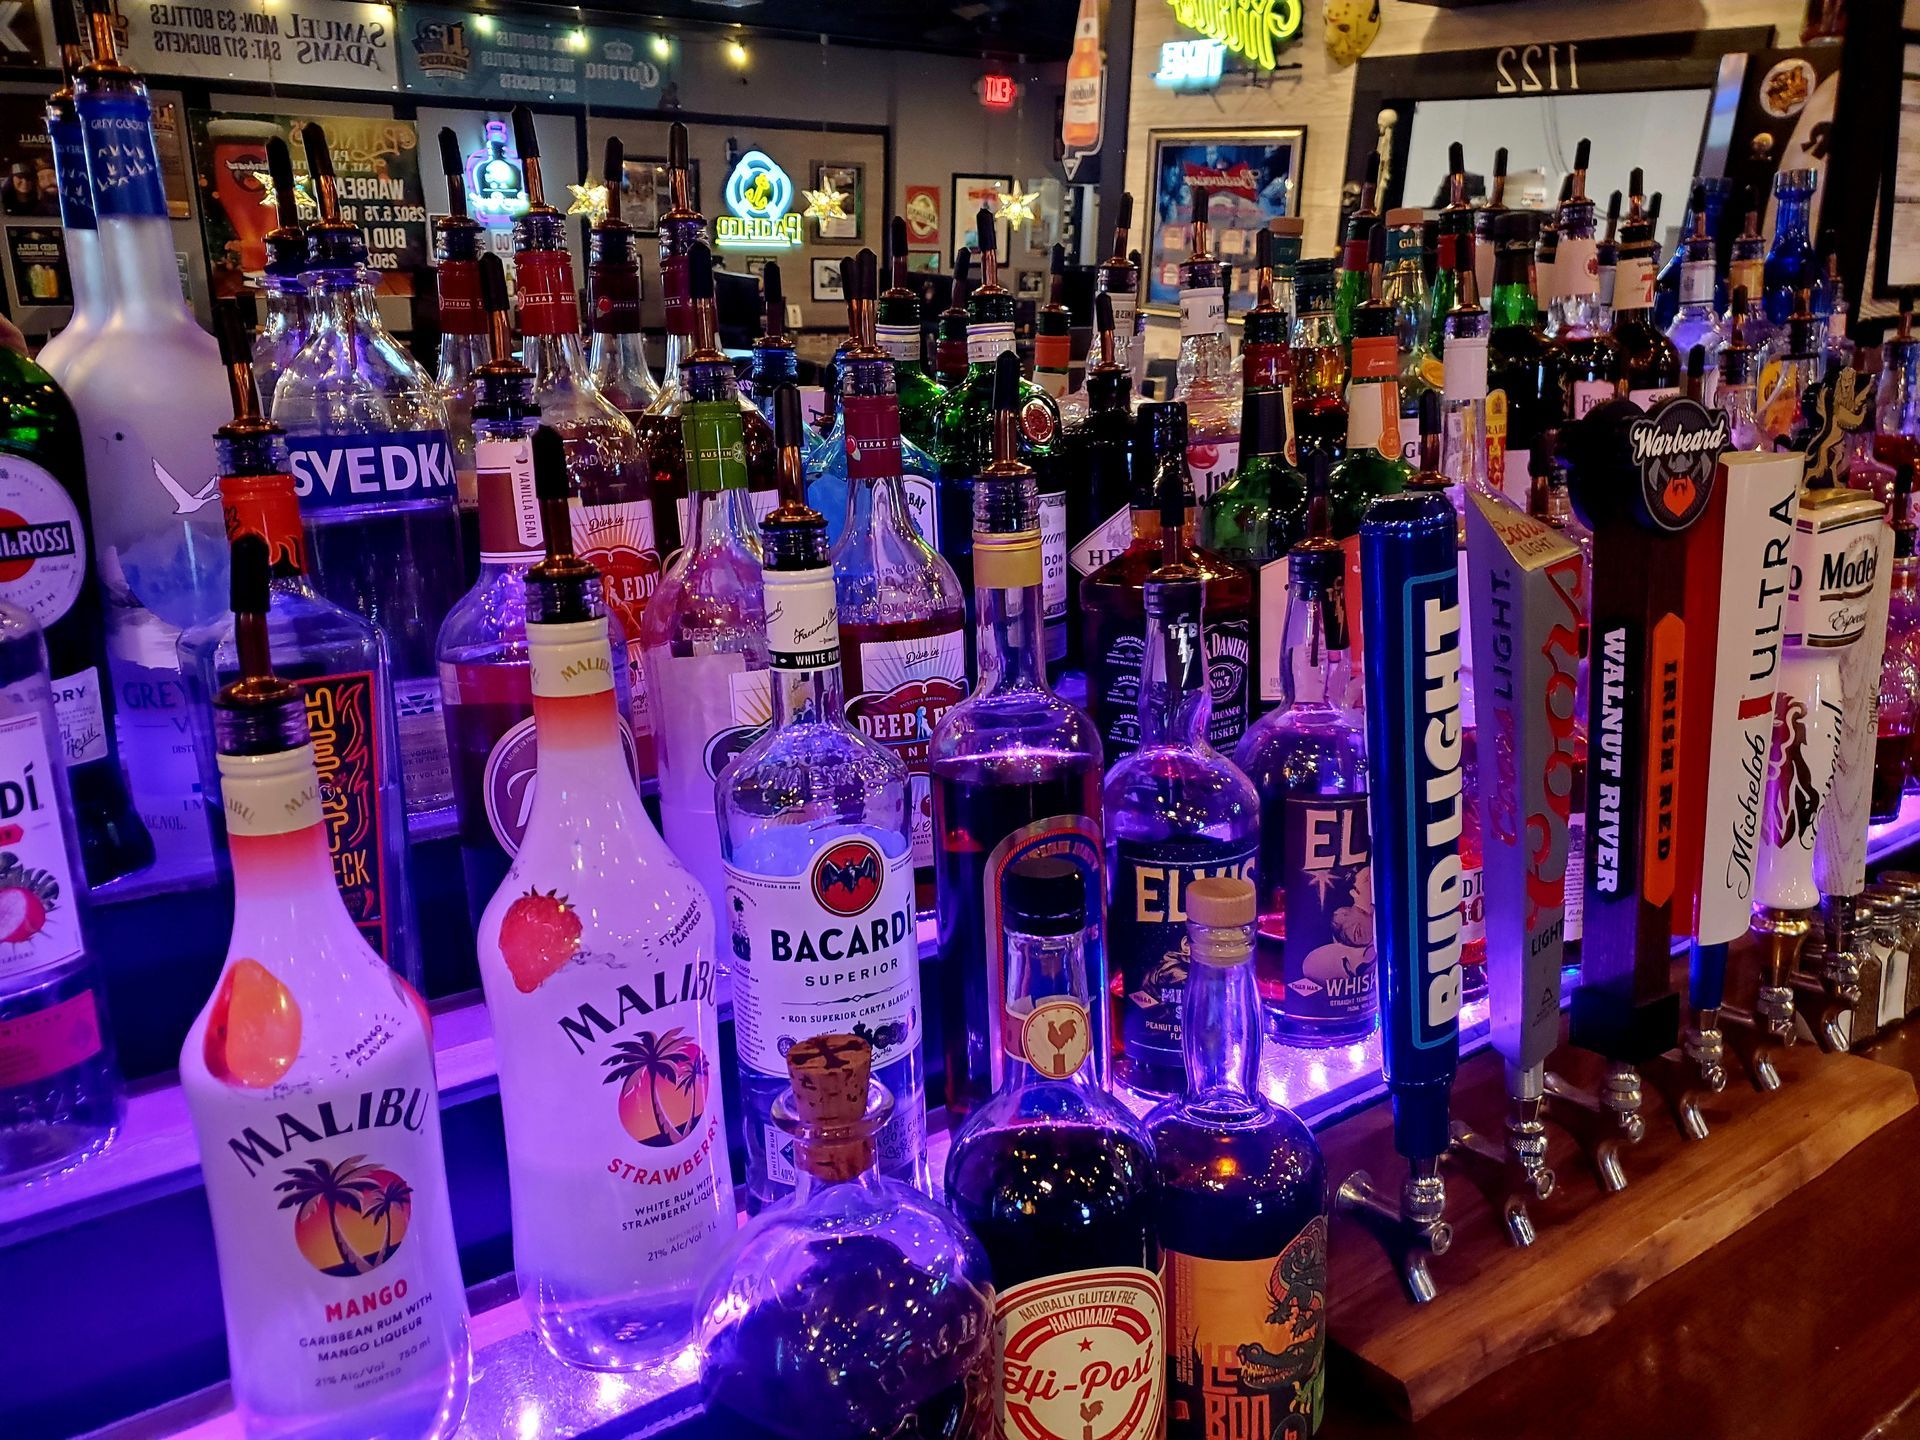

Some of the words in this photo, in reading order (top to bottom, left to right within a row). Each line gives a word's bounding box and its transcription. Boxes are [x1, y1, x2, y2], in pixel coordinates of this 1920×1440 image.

[700, 450, 732, 458] AUSTIN
[858, 440, 887, 448] TEXAS
[1633, 418, 1727, 462] Warbeard
[518, 471, 534, 511] VANILLA
[905, 492, 927, 515] BAY
[17, 526, 70, 555] ROSSI
[524, 513, 538, 539] BEAN
[588, 518, 613, 532] Dive
[615, 515, 625, 524] in
[1044, 552, 1063, 567] DON
[1519, 537, 1556, 557] LIGHT
[1047, 566, 1063, 579] GIN
[1748, 488, 1798, 683] ULTRA
[1490, 568, 1513, 701] LIGHT
[795, 653, 827, 666] WHITE
[905, 651, 929, 665] Dive
[930, 647, 940, 657] in
[1213, 670, 1225, 678] Old
[1598, 626, 1627, 768] WALNUT
[857, 712, 916, 738] DEEP
[1424, 597, 1463, 848] LIGHT
[1659, 660, 1678, 772] IRISH
[1595, 771, 1621, 895] RIVER
[1656, 780, 1676, 862] RED
[1726, 730, 1766, 900] Michelob
[658, 897, 698, 946] STRAWBERRY
[672, 910, 702, 948] FLAVORED
[770, 891, 914, 963] BACARDÍ
[1531, 920, 1563, 957] LIGHT
[1427, 853, 1464, 1029] BUD
[804, 957, 899, 987] SUPERIOR
[788, 1014, 807, 1023] RON
[810, 1010, 857, 1023] SUPERIOR
[859, 1004, 886, 1017] CARTA
[1145, 1020, 1172, 1032] PEANUT
[345, 1024, 382, 1060] MANGO
[356, 1031, 395, 1067] FLAVOR
[227, 1087, 430, 1178] MALIBU
[607, 1114, 718, 1185] STRAWBERRY
[621, 1201, 691, 1231] STRAWBERRY
[635, 1198, 671, 1217] WHITE
[674, 1189, 695, 1204] RUM
[647, 1248, 668, 1262] 21%
[670, 1231, 703, 1254] Alc/Vol
[325, 1278, 408, 1323] MANGO
[1017, 1295, 1075, 1323] NATURALLY
[1078, 1292, 1116, 1307] GLUTEN
[1116, 1290, 1138, 1305] FREE
[298, 1325, 373, 1348] CARIBBEAN
[377, 1311, 403, 1330] RUM
[405, 1292, 433, 1316] WITH
[1048, 1307, 1120, 1335] HANDMADE
[318, 1342, 370, 1362] MANGO
[373, 1316, 423, 1348] LIQUEUR
[315, 1375, 337, 1387] 21%
[398, 1345, 418, 1361] 750
[1001, 1339, 1155, 1402] Hi-Post
